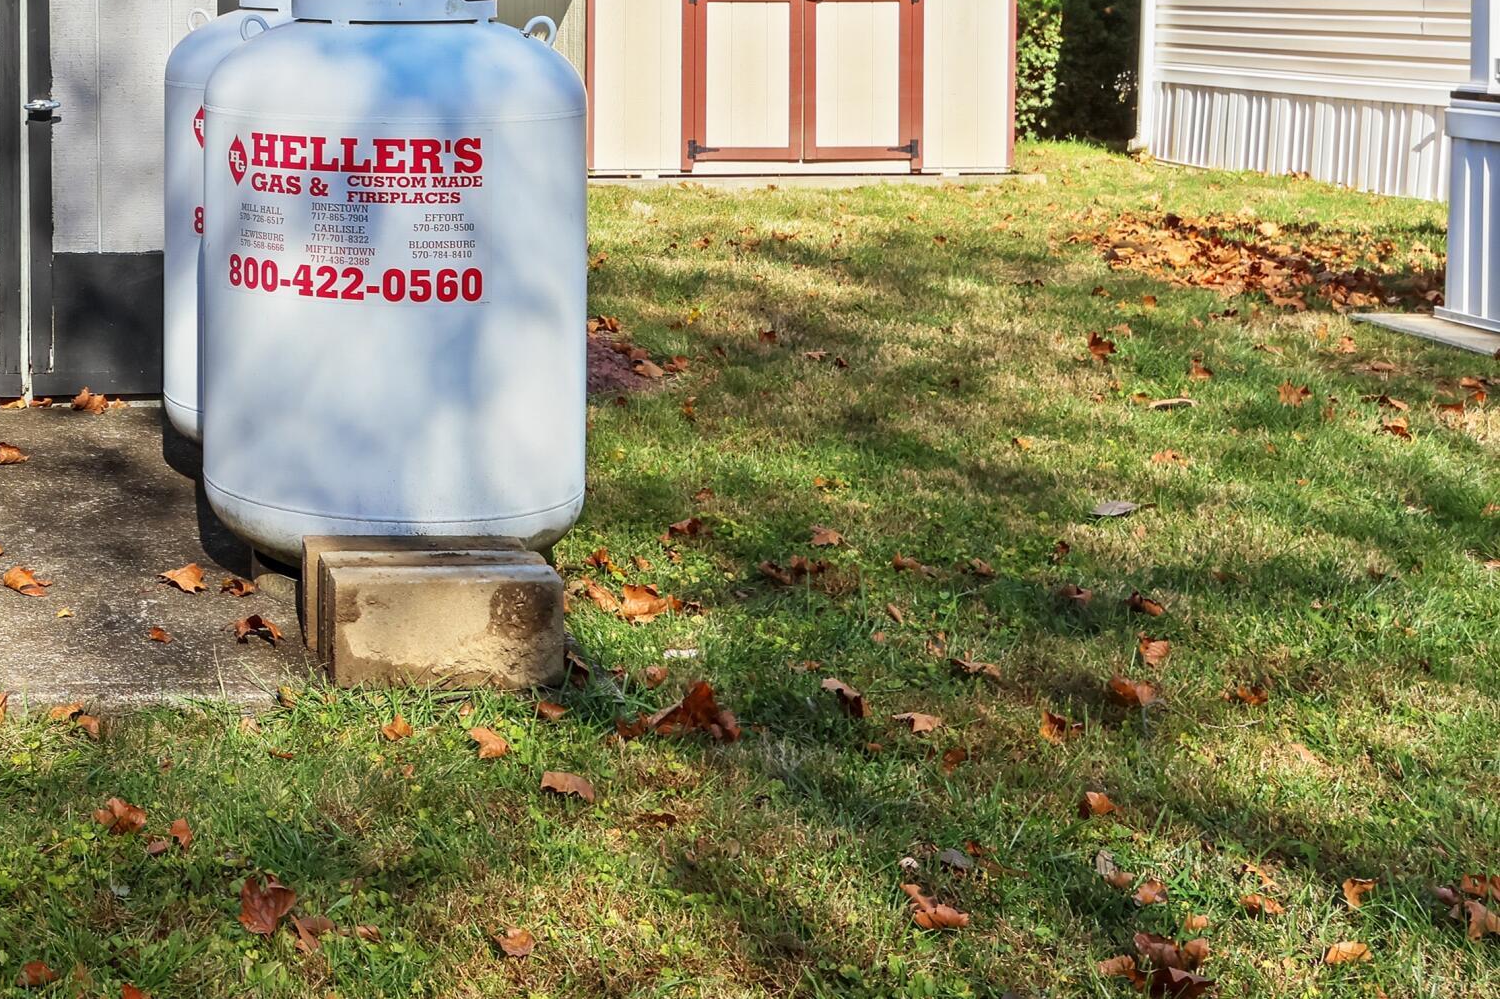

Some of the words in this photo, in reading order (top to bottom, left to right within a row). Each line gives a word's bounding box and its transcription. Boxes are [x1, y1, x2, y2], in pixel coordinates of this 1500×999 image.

[251, 132, 484, 174] HELLER'S
[251, 172, 301, 196] GAS
[309, 177, 329, 197] &
[346, 176, 427, 188] CUSTOM
[432, 176, 483, 188] MADE
[346, 191, 461, 204] FIREPLACES
[260, 206, 282, 215] HALL
[311, 202, 369, 213] JONESTOWN
[311, 212, 369, 222] 717-865-7904
[425, 213, 465, 222] EFFORT
[314, 223, 365, 234] CARLISLE
[413, 223, 475, 232] 570-620-9500
[240, 228, 284, 241] LEWISBURG
[311, 233, 369, 244] 717-701-8322
[240, 239, 284, 252] 570-568-6666
[305, 244, 375, 256] MIFFLINTOWN
[408, 240, 476, 249] BLOOMSBURG
[412, 250, 472, 259] 570-784-8410
[311, 255, 370, 266] 717-436-2388
[229, 253, 483, 303] 800-422-0560
